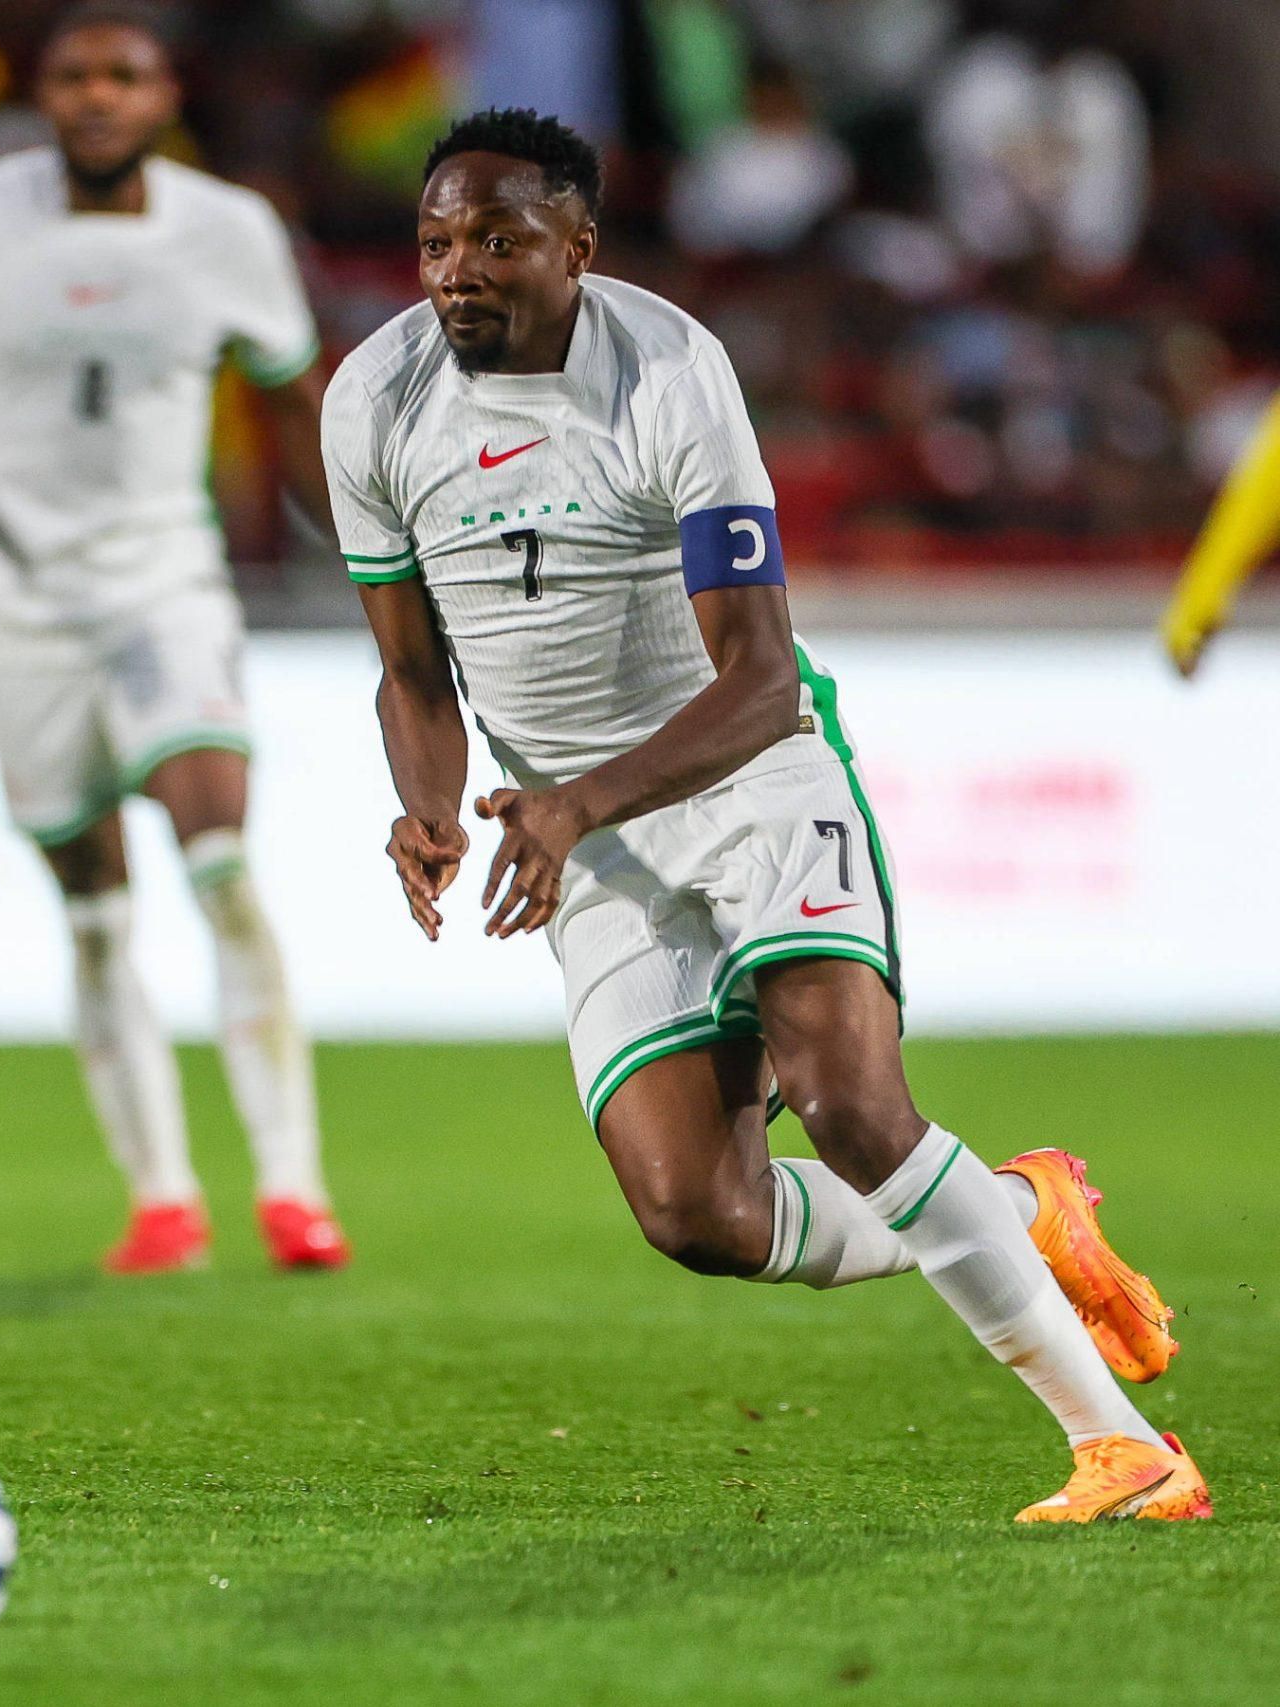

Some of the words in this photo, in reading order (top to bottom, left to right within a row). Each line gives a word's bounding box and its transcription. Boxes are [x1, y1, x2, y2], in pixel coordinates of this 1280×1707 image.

[460, 501, 582, 526] NAIJA
[500, 528, 544, 602] 7
[812, 819, 854, 893] 7
